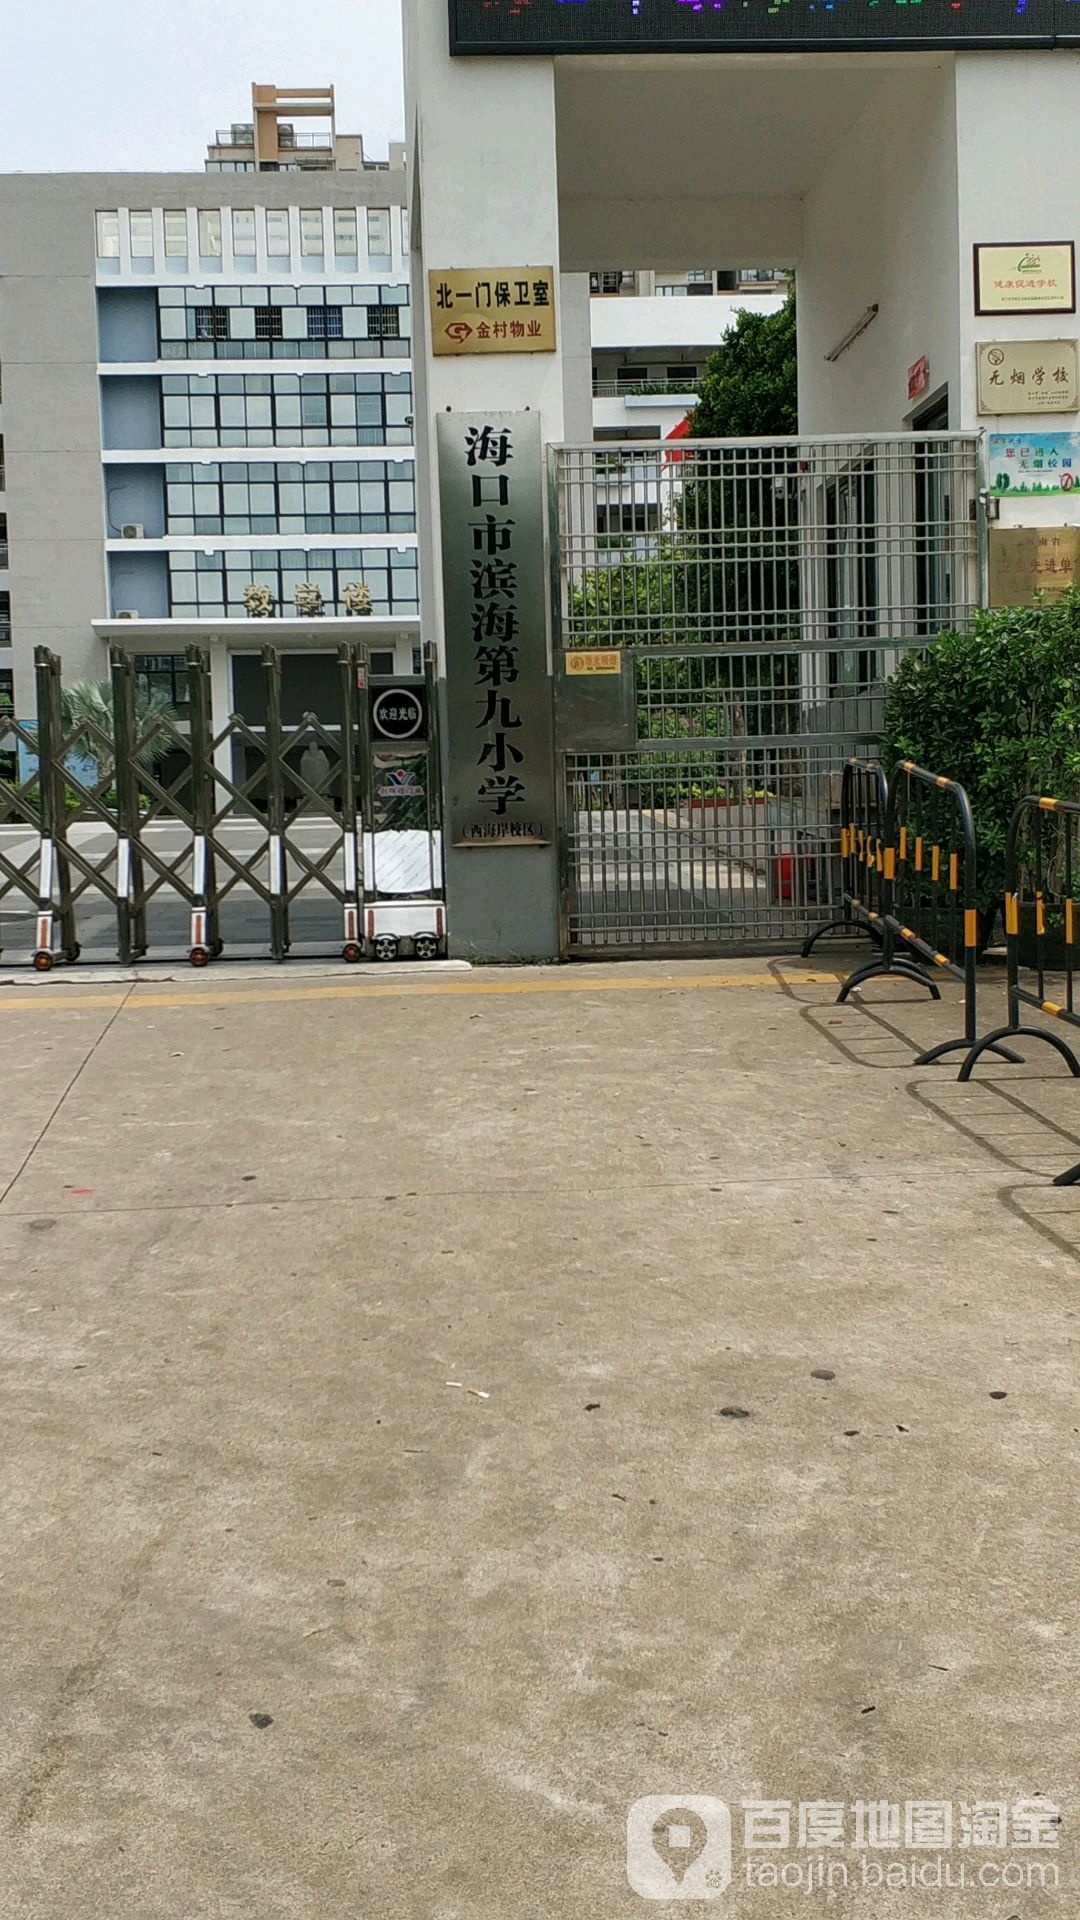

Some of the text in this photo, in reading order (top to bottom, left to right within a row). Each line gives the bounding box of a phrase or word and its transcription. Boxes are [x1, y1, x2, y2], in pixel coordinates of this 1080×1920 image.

[993, 279, 1058, 289] 健康促进学校
[436, 280, 550, 309] 北一门保卫室
[476, 320, 542, 339] 金村物业
[988, 366, 1069, 386] 无烟学校
[1005, 447, 1059, 458] 您已进入
[1018, 458, 1072, 469] 无烟校园
[464, 426, 526, 816] 海口市滨海第九小学
[379, 707, 417, 721] 欢迎光临
